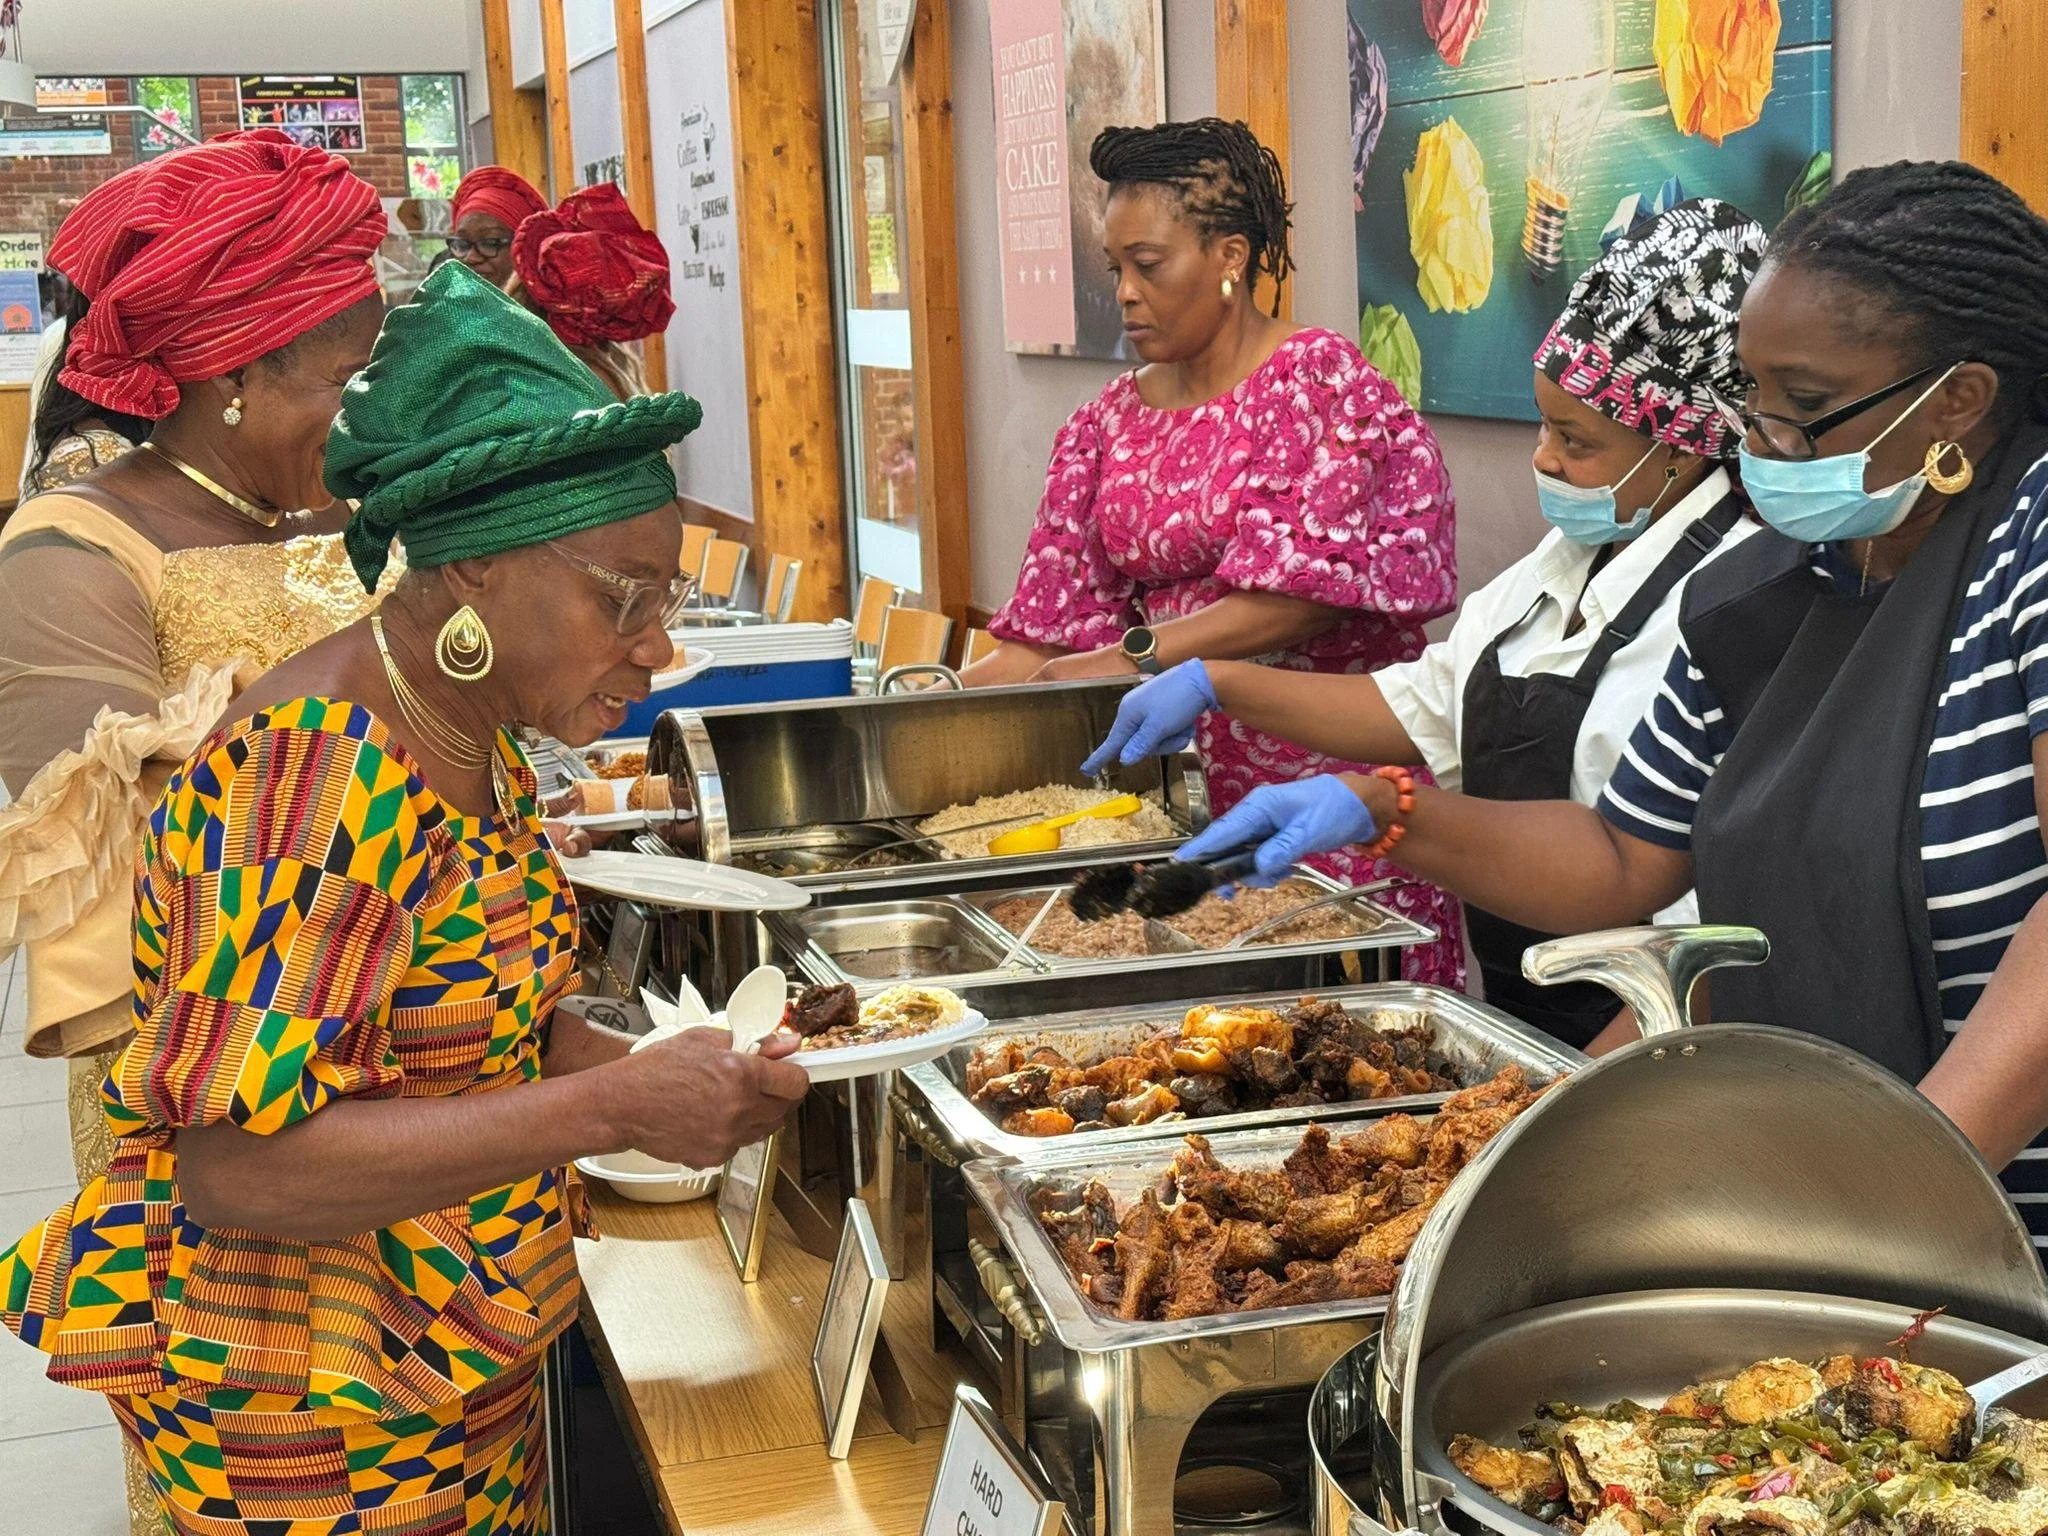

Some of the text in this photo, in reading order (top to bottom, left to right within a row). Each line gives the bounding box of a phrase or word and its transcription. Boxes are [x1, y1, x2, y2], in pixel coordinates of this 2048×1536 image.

[1001, 62, 1057, 118] HAPPINESS
[1005, 141, 1060, 192] CAKE
[0, 239, 40, 251] Order
[588, 562, 620, 585] VERSACE
[970, 1459, 1003, 1518] HARD
